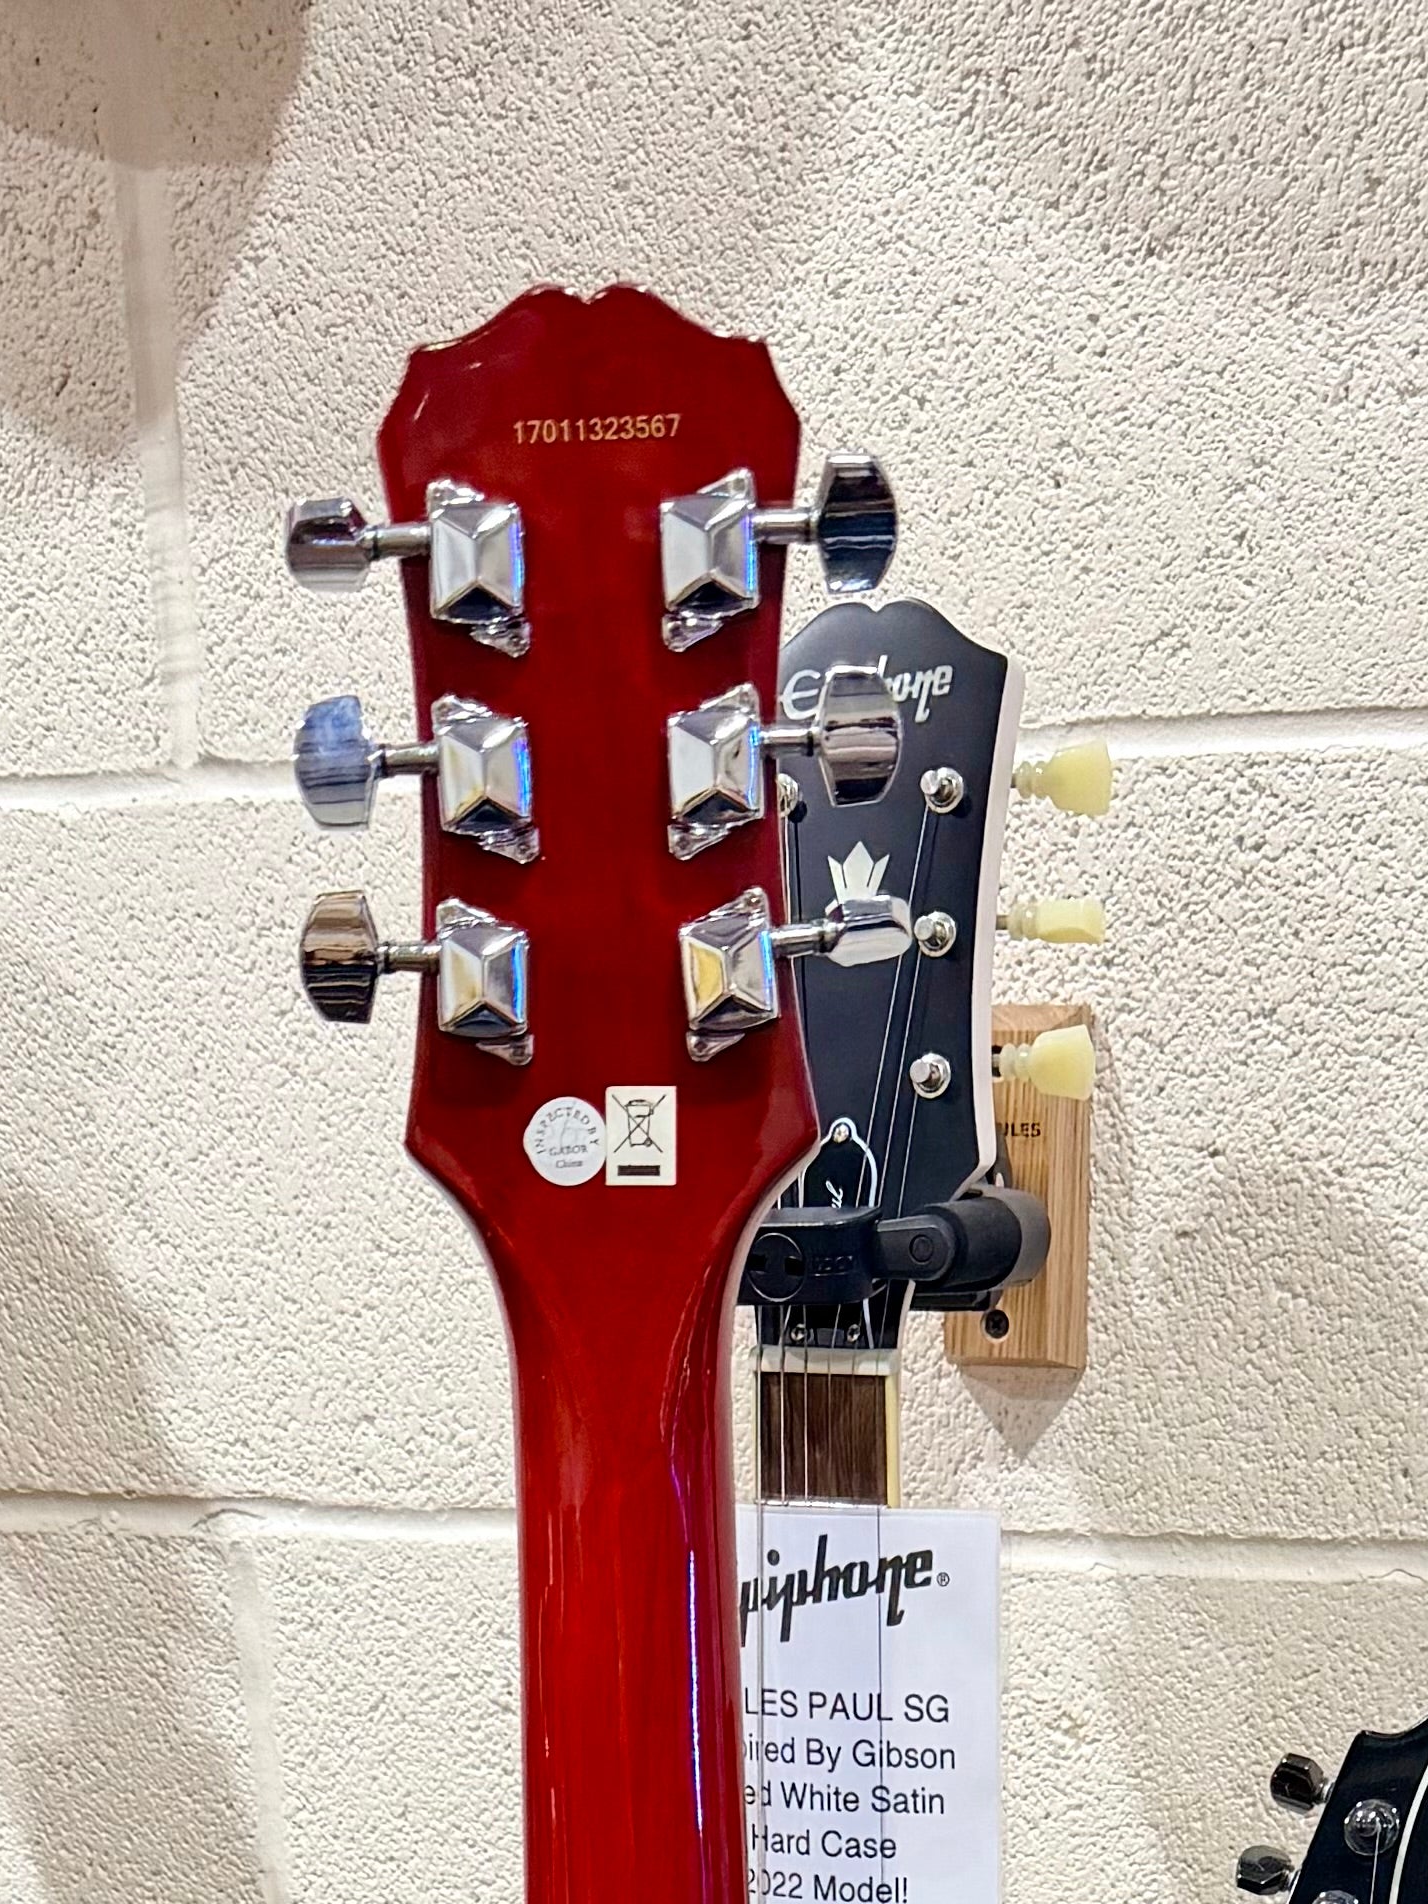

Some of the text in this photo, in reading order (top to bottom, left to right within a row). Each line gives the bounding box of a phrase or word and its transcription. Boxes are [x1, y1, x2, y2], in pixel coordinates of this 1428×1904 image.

[512, 413, 682, 445] 17011323567
[779, 654, 954, 724] Ehone
[739, 1533, 934, 1648] piphone
[744, 1686, 949, 1723] LES PAUL SG
[742, 1732, 956, 1774] ired By Gibson
[744, 1780, 945, 1815] ed White Satin
[751, 1823, 898, 1860] Hard Case
[812, 1874, 909, 1904] Model!
